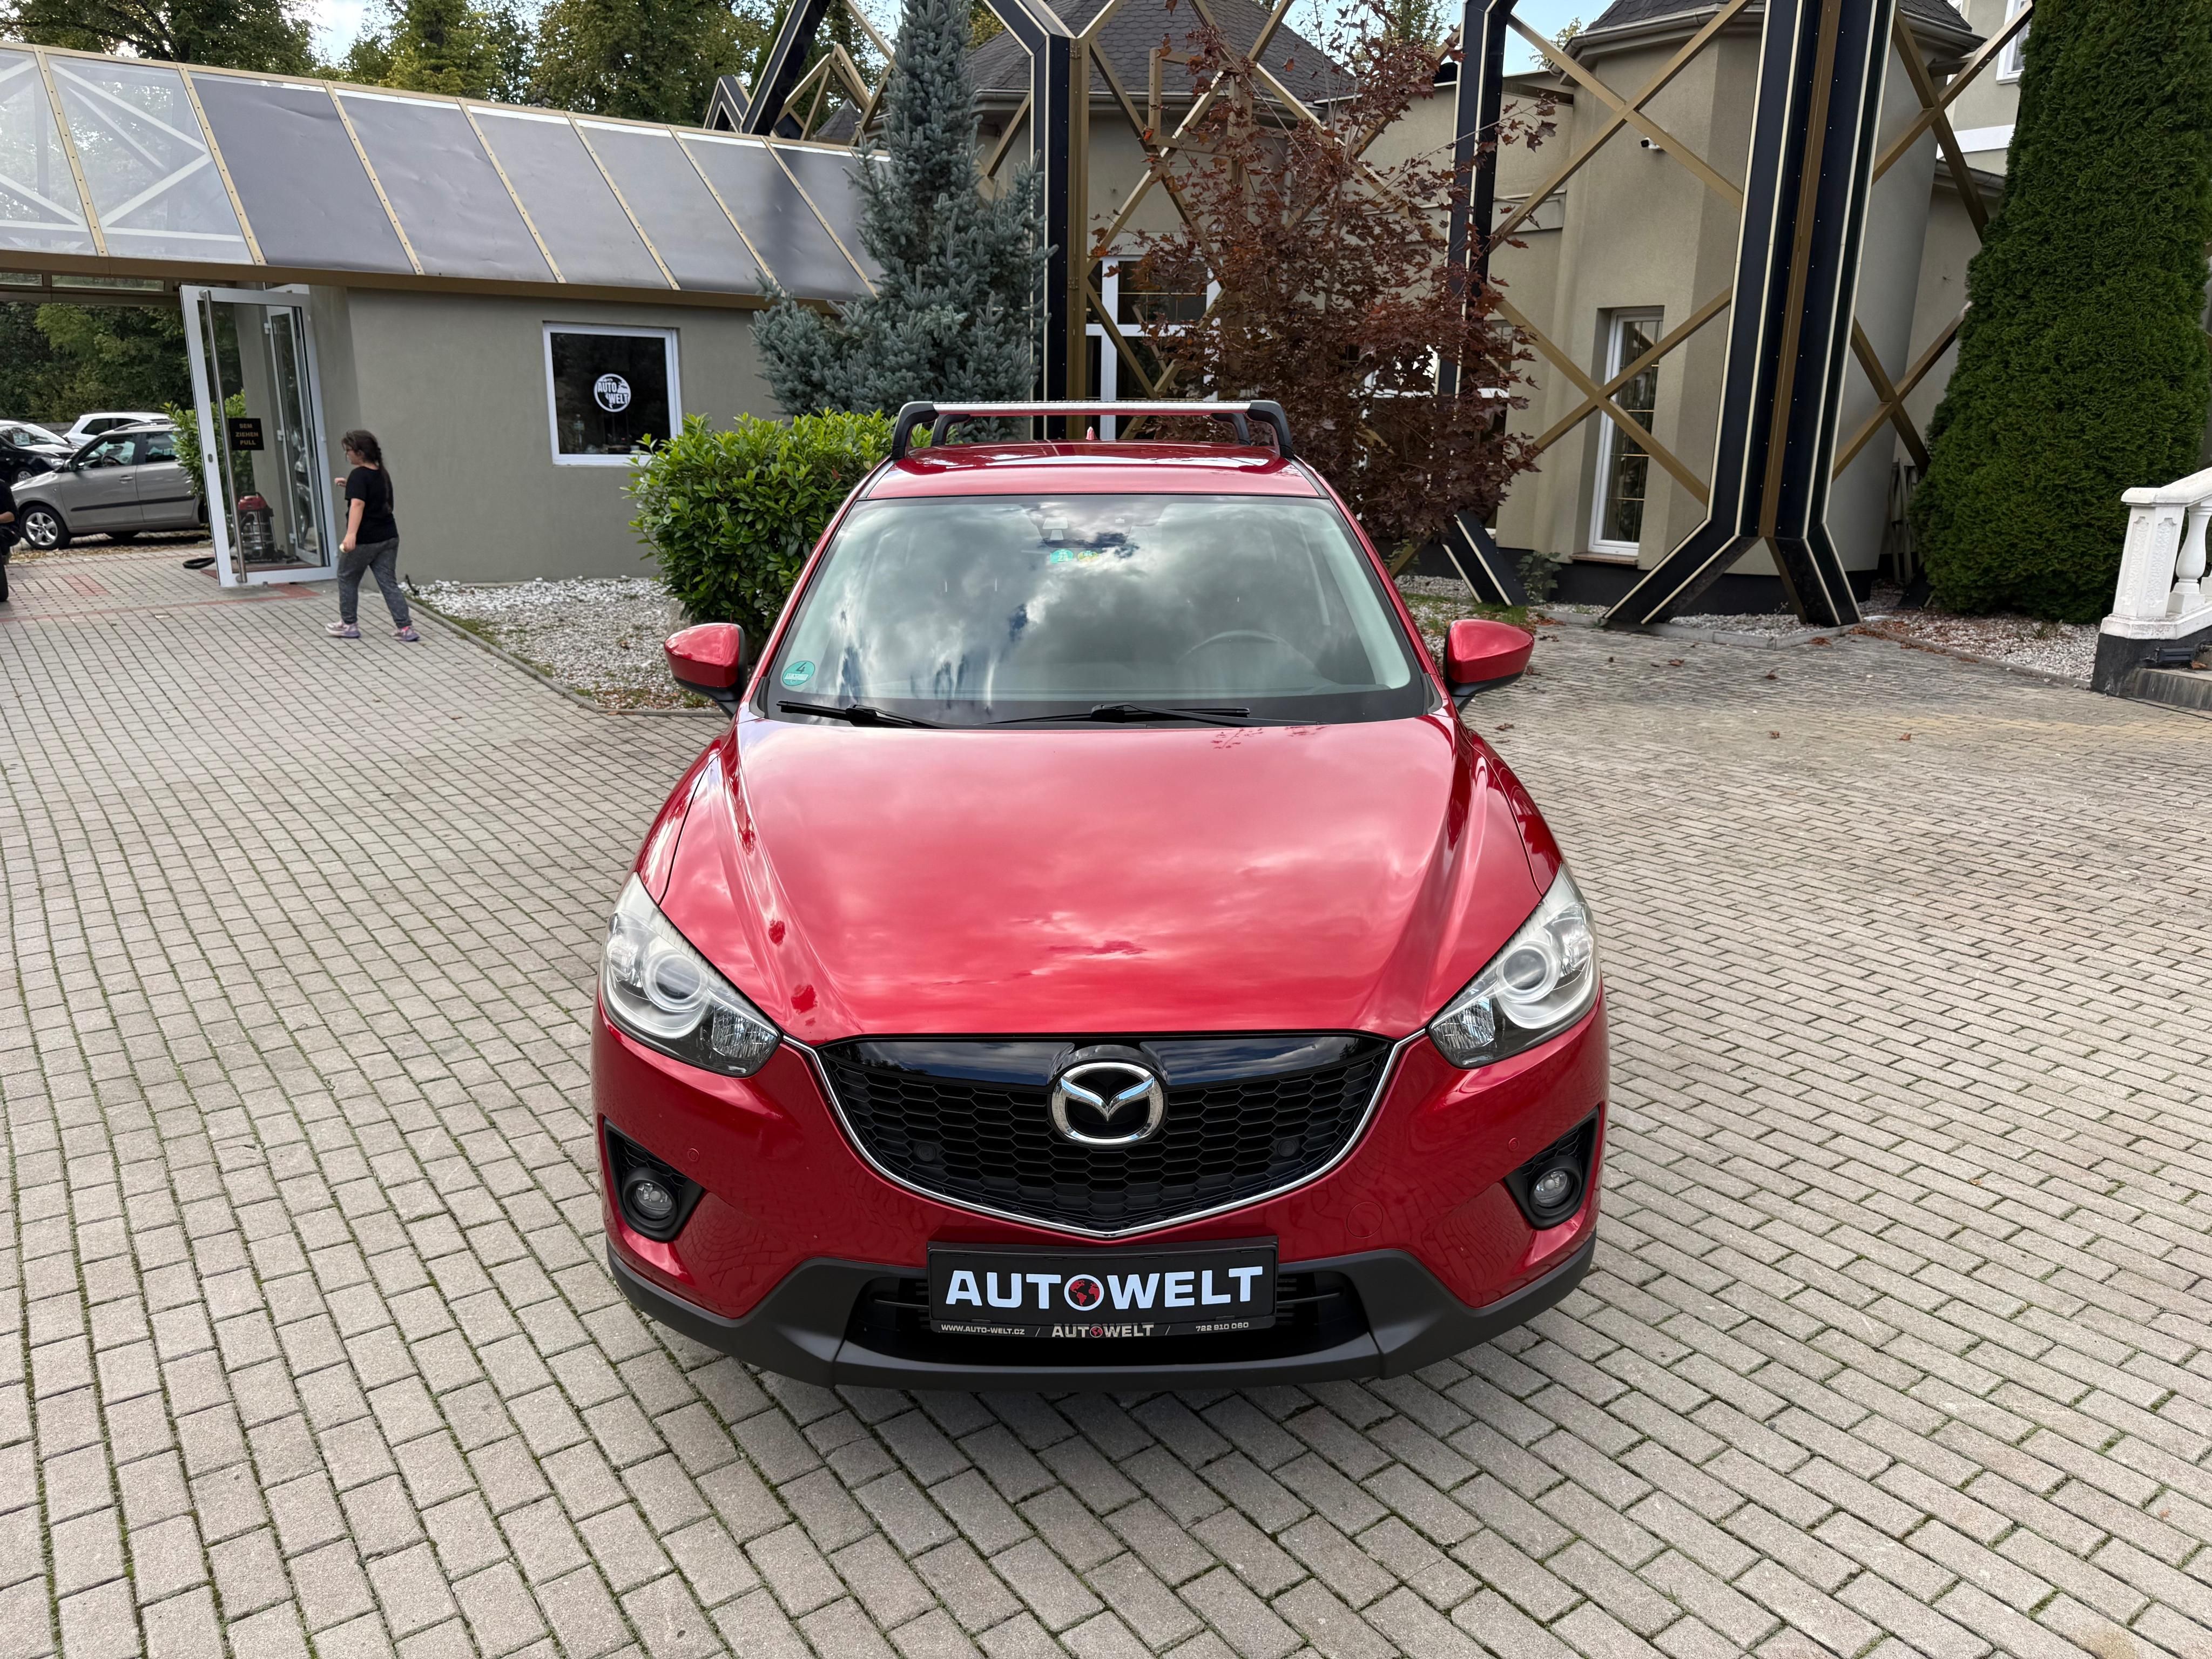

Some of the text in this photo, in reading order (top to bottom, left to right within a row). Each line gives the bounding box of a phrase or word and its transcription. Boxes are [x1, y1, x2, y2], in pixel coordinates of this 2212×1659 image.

[598, 382, 617, 393] AUTO
[609, 393, 628, 404] WELT
[796, 662, 807, 674] 4
[945, 1266, 1263, 1311] AUTOWELT
[941, 1324, 1025, 1336] WWW.AUTO-WELT.CZ
[1051, 1324, 1154, 1338] AUTOWELT
